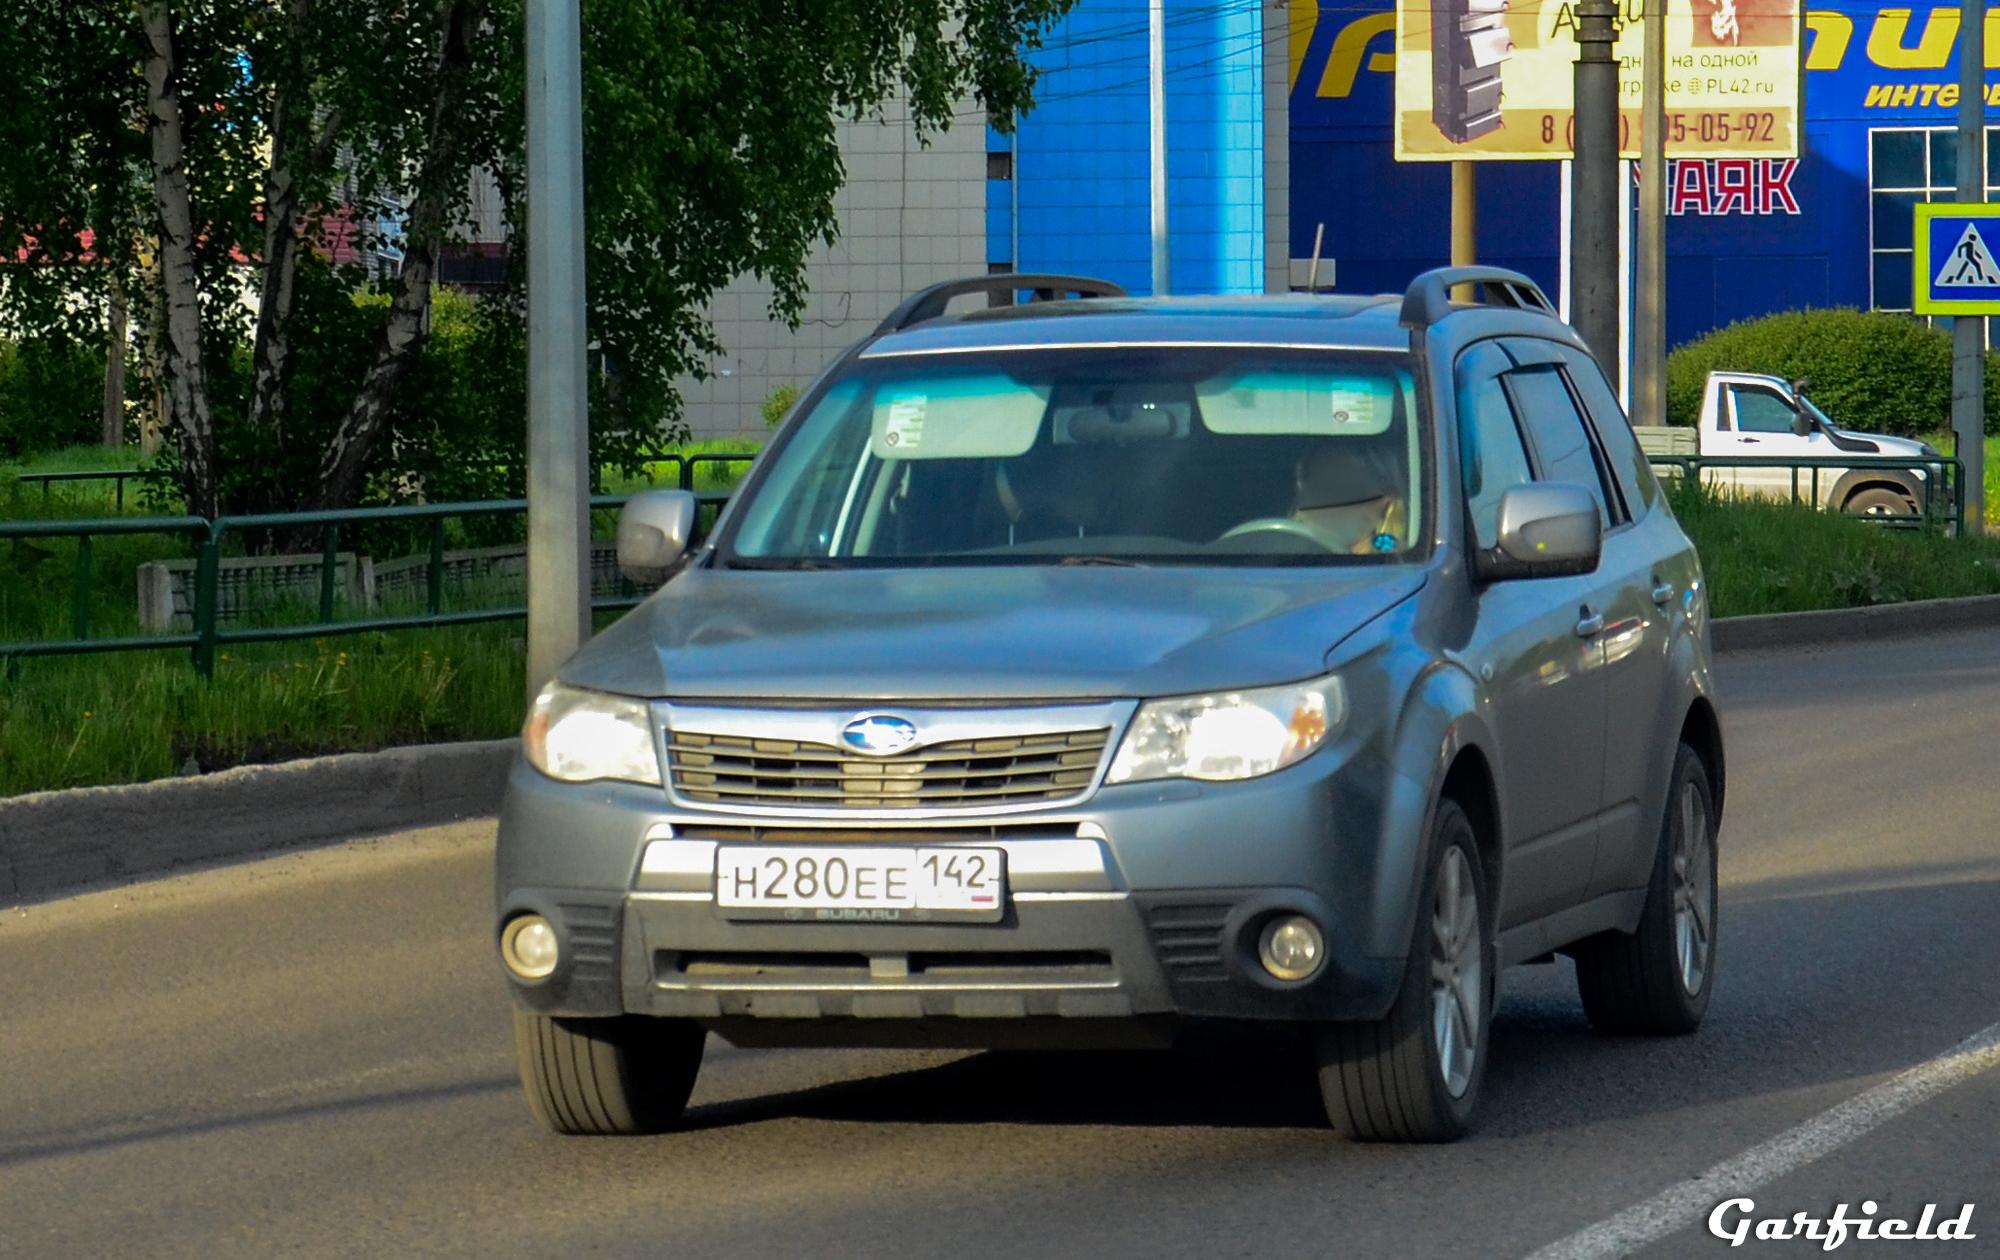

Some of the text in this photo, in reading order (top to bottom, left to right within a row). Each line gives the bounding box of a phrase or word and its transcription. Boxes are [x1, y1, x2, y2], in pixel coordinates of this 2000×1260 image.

[1672, 55, 1693, 68] на
[1700, 50, 1758, 69] одной
[1541, 114, 1554, 144] 8
[1633, 159, 1801, 215] АЯК
[923, 855, 986, 887] 142
